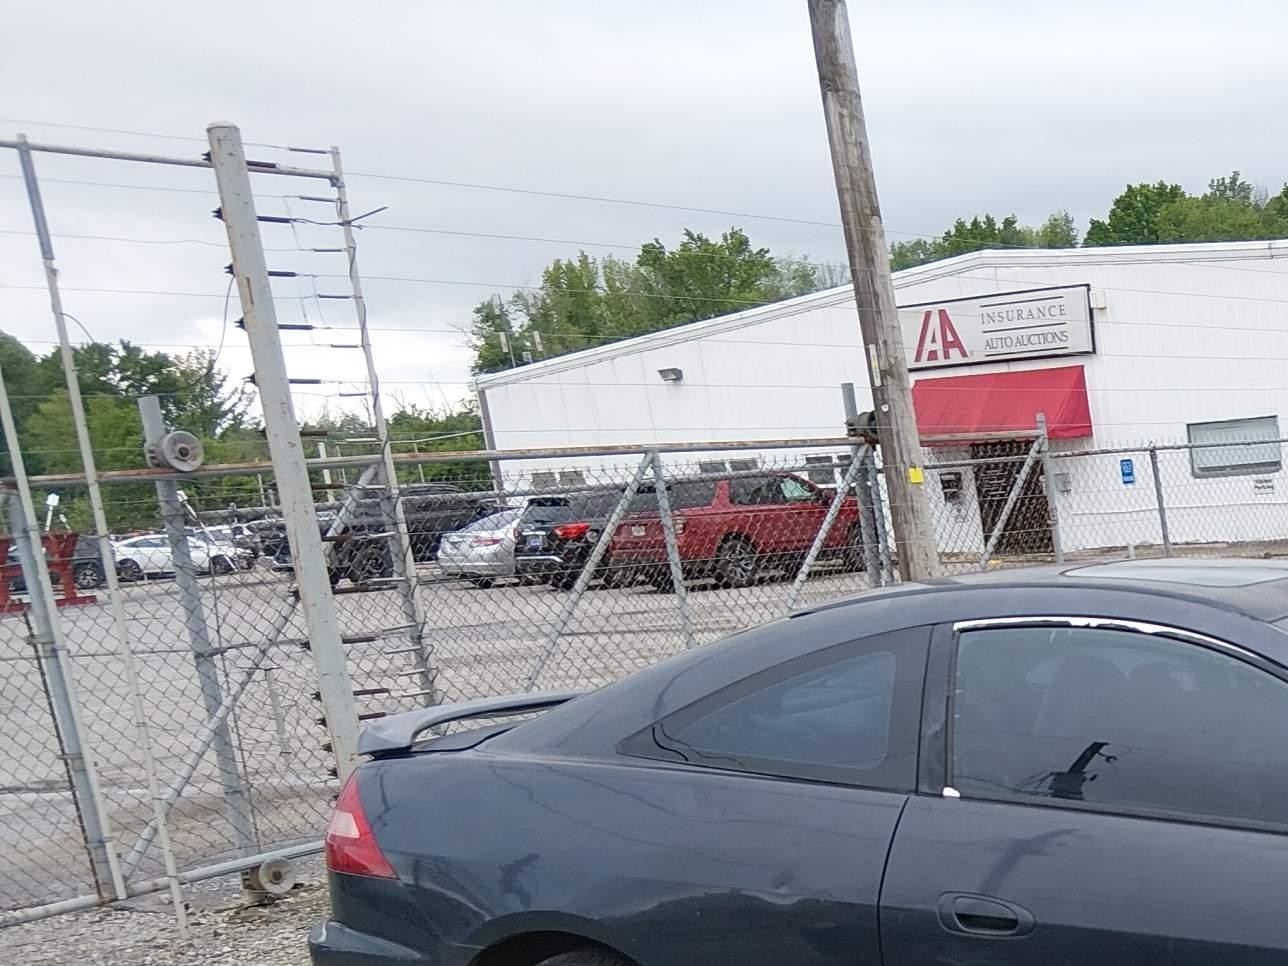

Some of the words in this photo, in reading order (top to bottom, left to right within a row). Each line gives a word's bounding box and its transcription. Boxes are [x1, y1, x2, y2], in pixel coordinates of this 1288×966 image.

[981, 304, 1067, 325] INSURANCE
[984, 335, 1015, 351] AUTO
[1014, 330, 1069, 347] AUCTIONS
